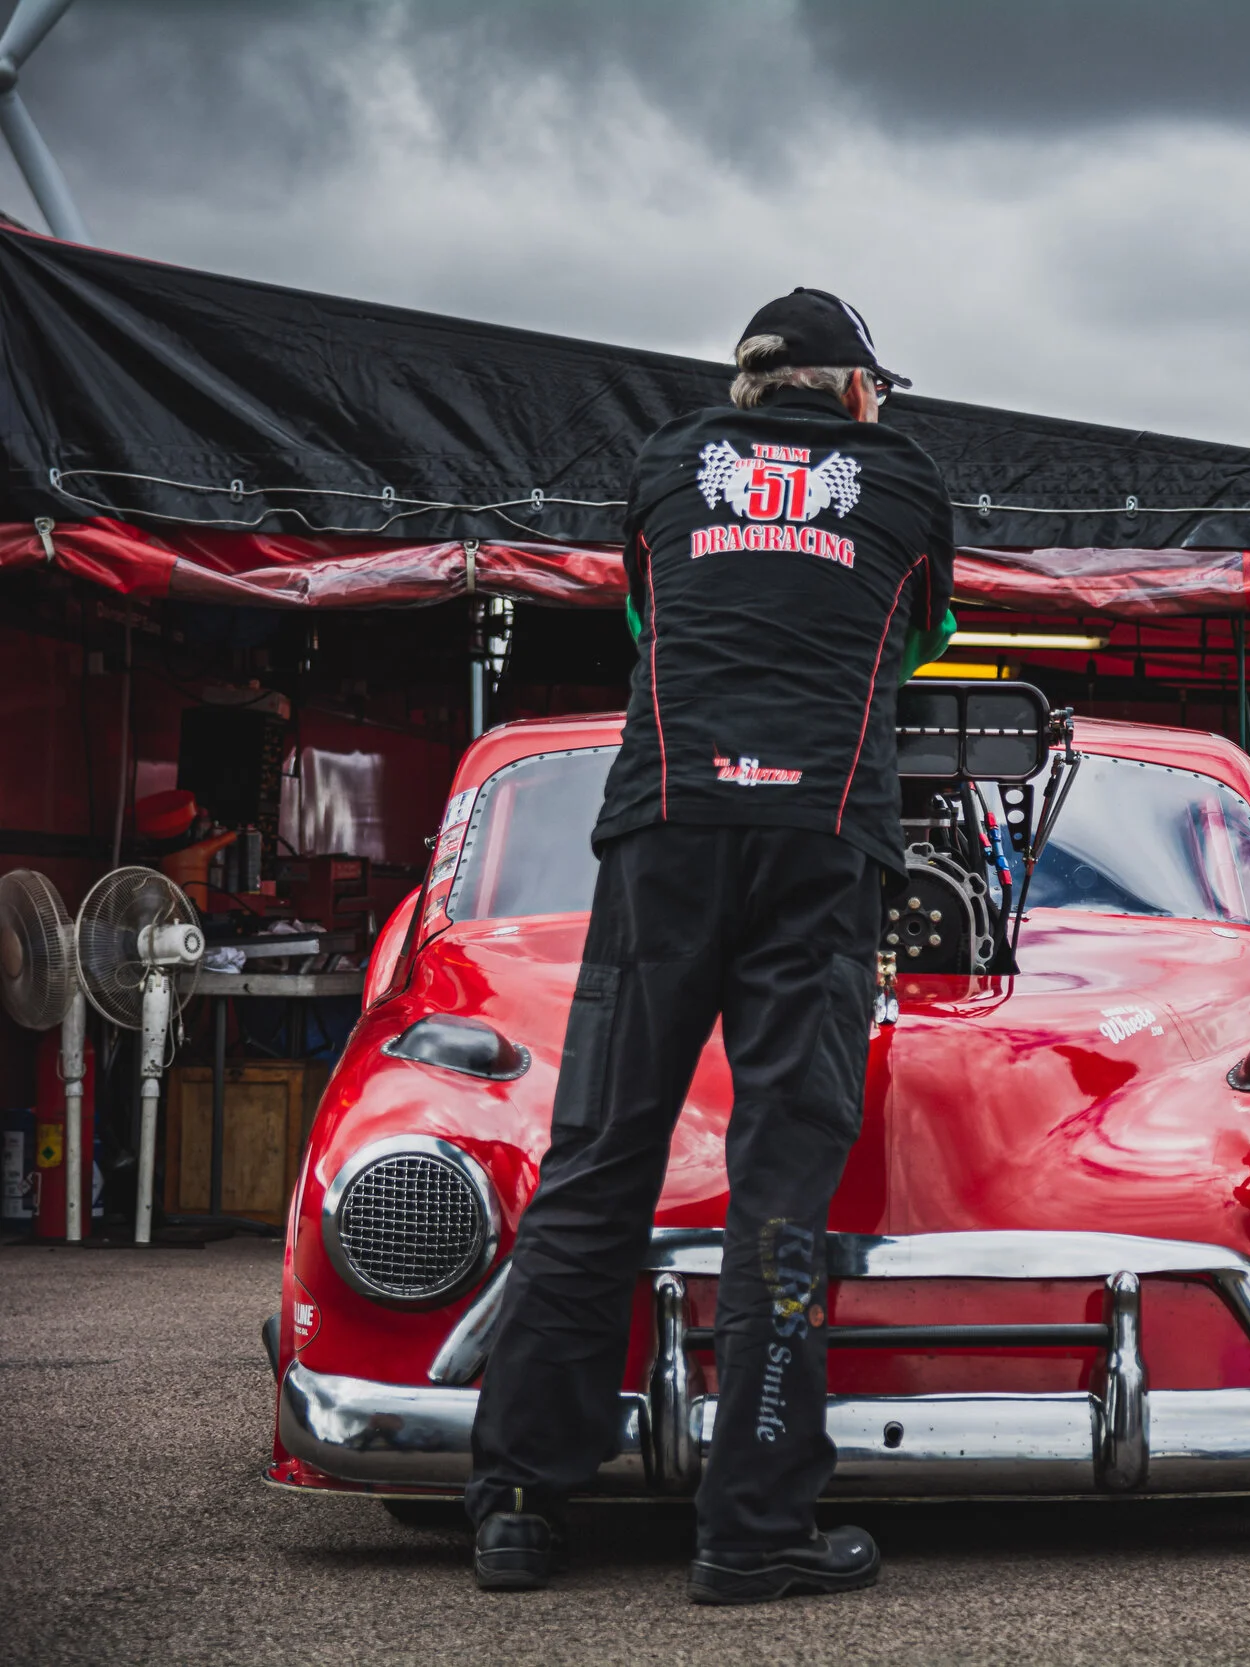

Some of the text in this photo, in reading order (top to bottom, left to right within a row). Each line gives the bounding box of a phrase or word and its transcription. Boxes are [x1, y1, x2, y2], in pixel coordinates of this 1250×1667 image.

[752, 443, 811, 463] TEAM
[748, 465, 808, 522] 51
[691, 524, 856, 568] DRAGRACING
